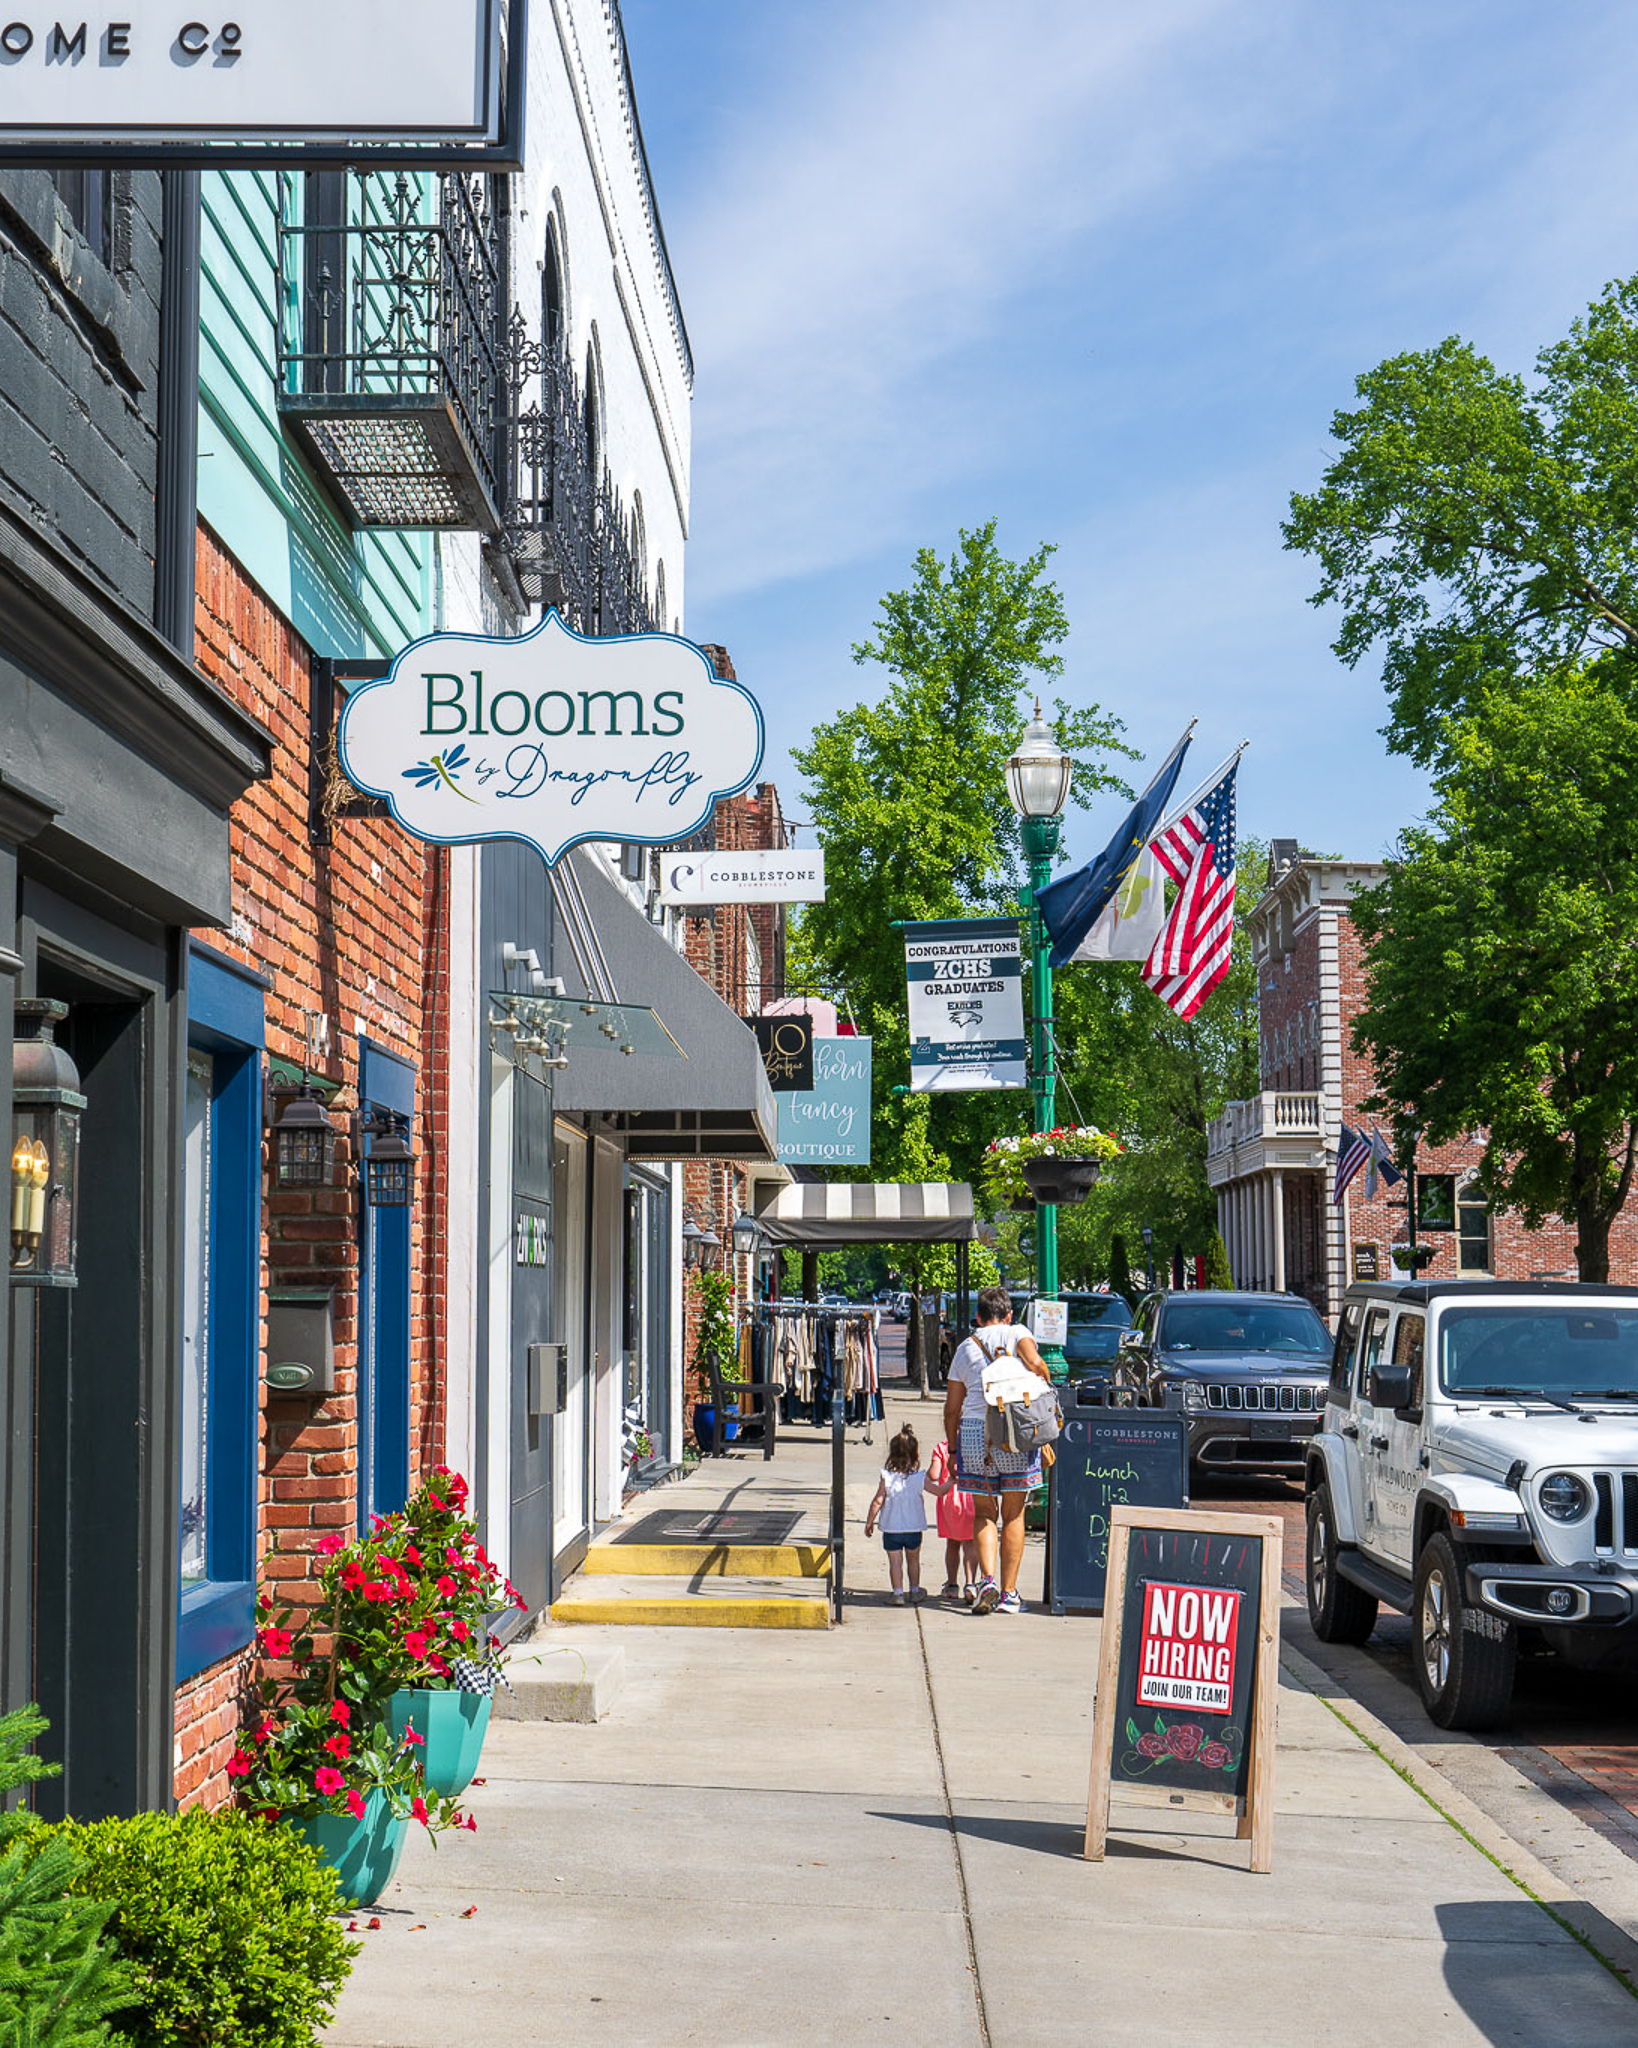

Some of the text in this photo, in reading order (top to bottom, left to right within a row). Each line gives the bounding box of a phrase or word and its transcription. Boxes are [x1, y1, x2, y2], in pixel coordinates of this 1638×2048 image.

[420, 671, 685, 736] Blooms
[475, 742, 703, 806] by Dragonfly
[710, 871, 816, 882] COBBLESTONE
[908, 942, 1018, 957] CONGRATULATIONS
[933, 959, 993, 979] ZCHS
[924, 981, 1005, 996] GRADUATES
[777, 1143, 856, 1159] BOUTIQUE
[1095, 1428, 1179, 1440] COBBLESTONE
[1085, 1457, 1140, 1483] Lunch
[1149, 1588, 1234, 1645] NOW
[1144, 1640, 1230, 1683] HIRING
[1143, 1680, 1227, 1704] JOIN OUR TEAM!
